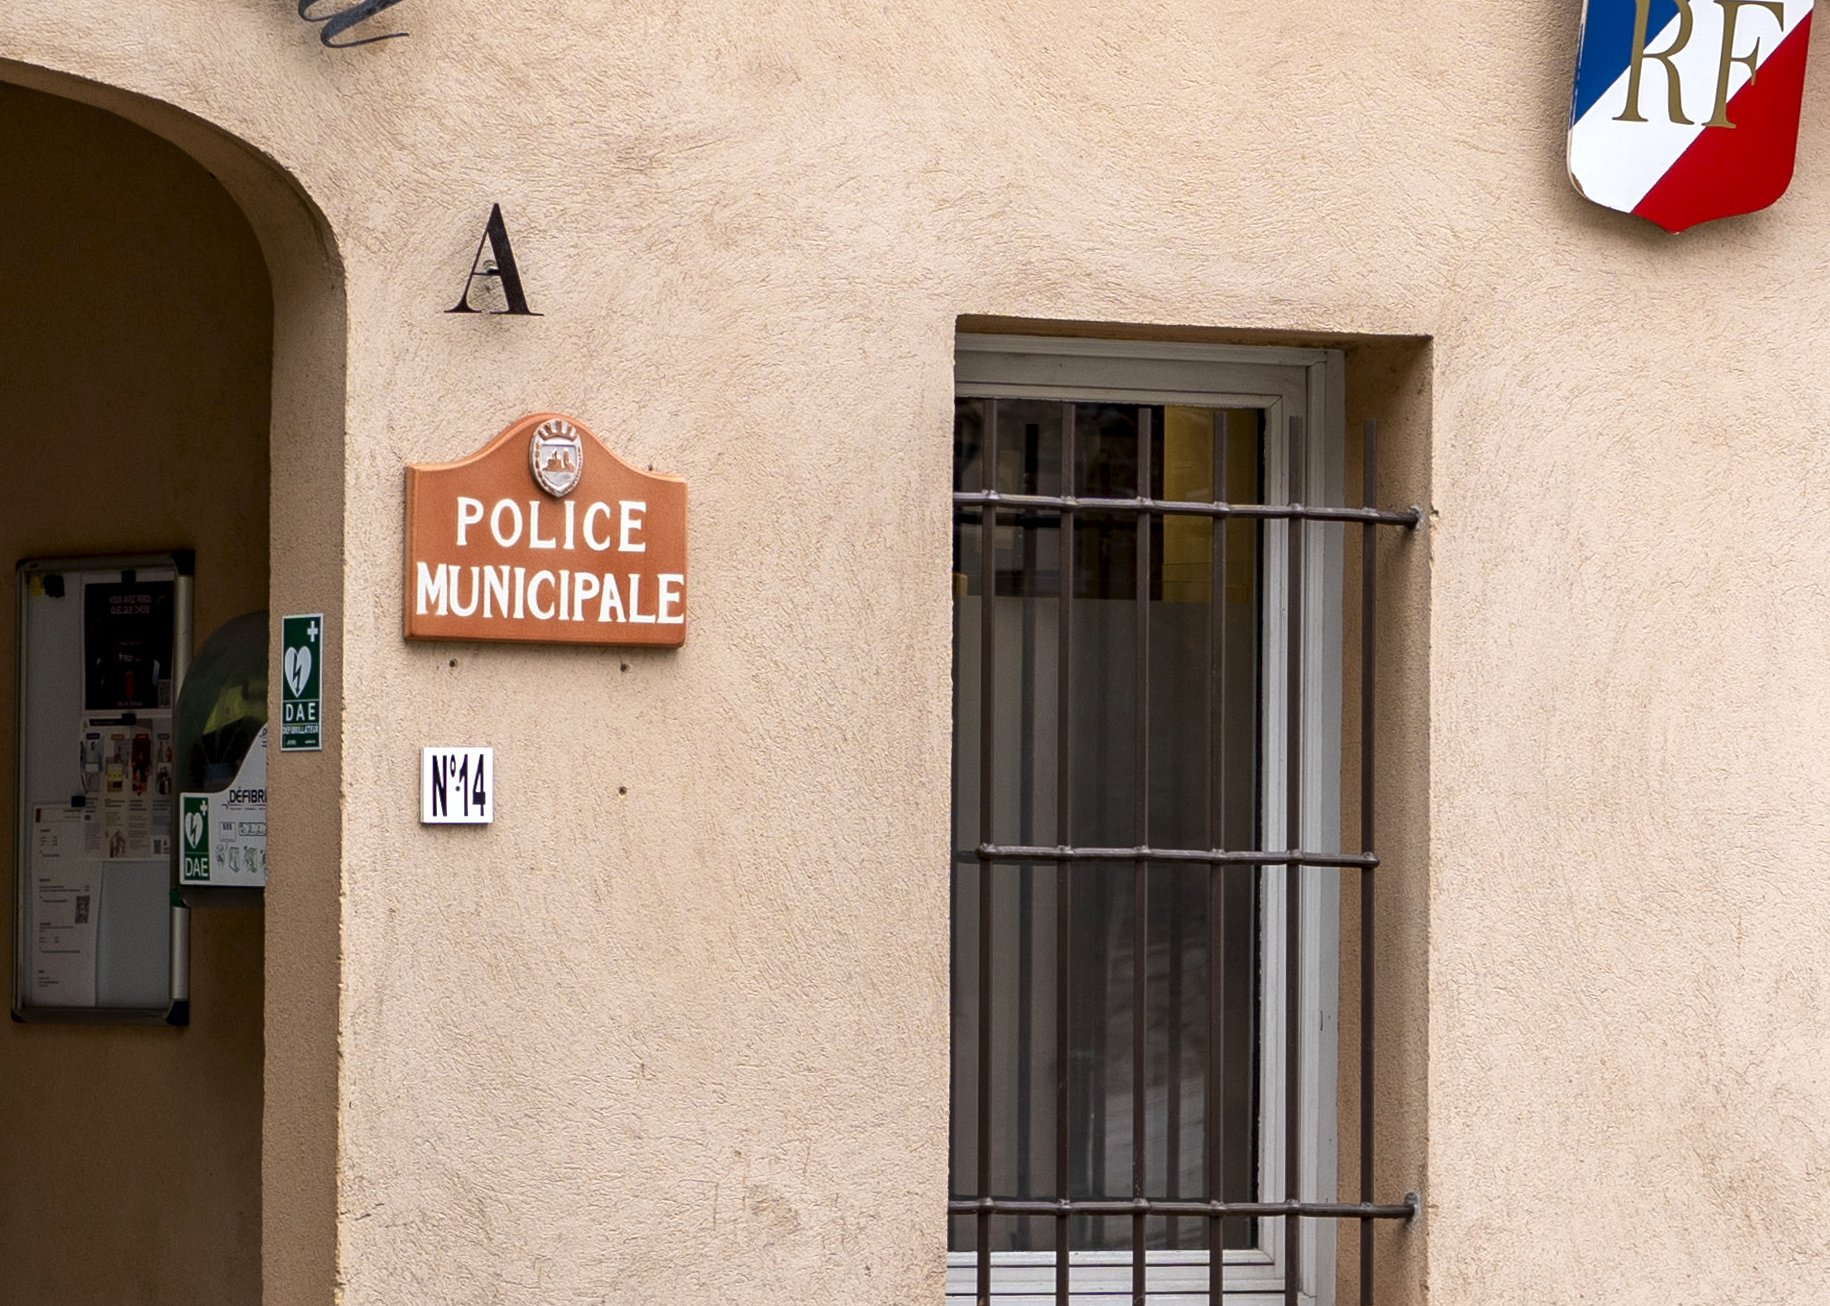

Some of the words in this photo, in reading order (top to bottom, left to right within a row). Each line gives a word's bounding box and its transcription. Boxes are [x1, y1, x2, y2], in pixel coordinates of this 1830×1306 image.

[444, 202, 545, 317] A
[456, 497, 648, 553] POLICE
[415, 562, 685, 625] MUNICIPALE
[286, 702, 316, 722] DAE
[185, 857, 209, 877] DAE
